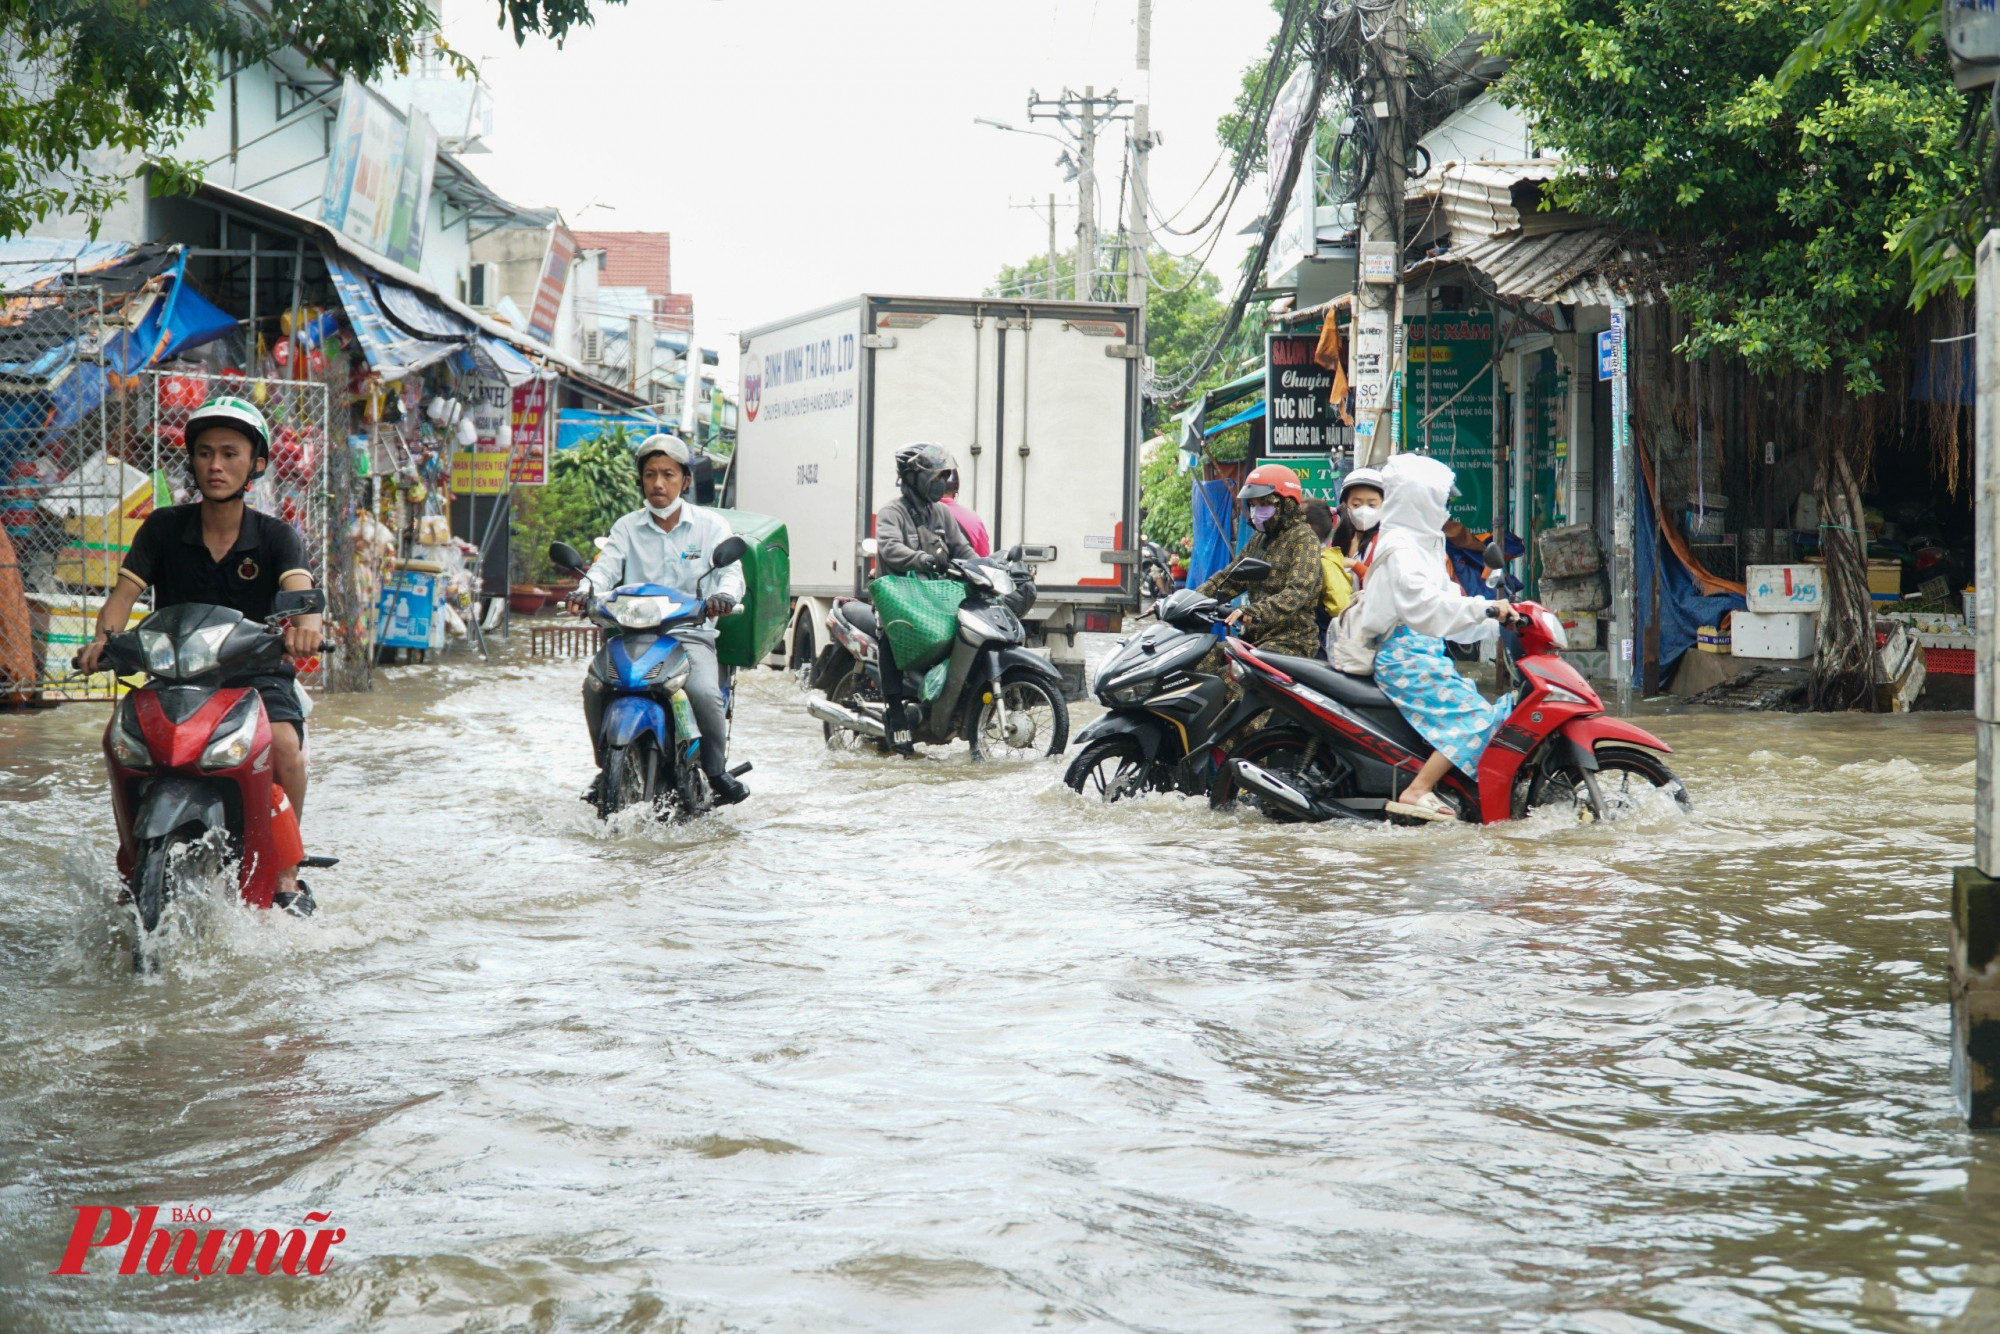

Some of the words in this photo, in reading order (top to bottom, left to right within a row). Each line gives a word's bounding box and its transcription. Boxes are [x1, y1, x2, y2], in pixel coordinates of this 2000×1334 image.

[1443, 320, 1491, 340] XĂM
[784, 346, 804, 384] MINH
[837, 333, 853, 372] LTD
[1272, 340, 1306, 365] SALON
[1281, 369, 1331, 392] Chuyên
[1273, 394, 1296, 419] TÓC
[1298, 393, 1316, 419] NỮ
[1273, 423, 1294, 446] CHĂM
[1295, 423, 1310, 446] SÓC
[1311, 426, 1320, 445] DA
[1162, 677, 1190, 690] HONDA
